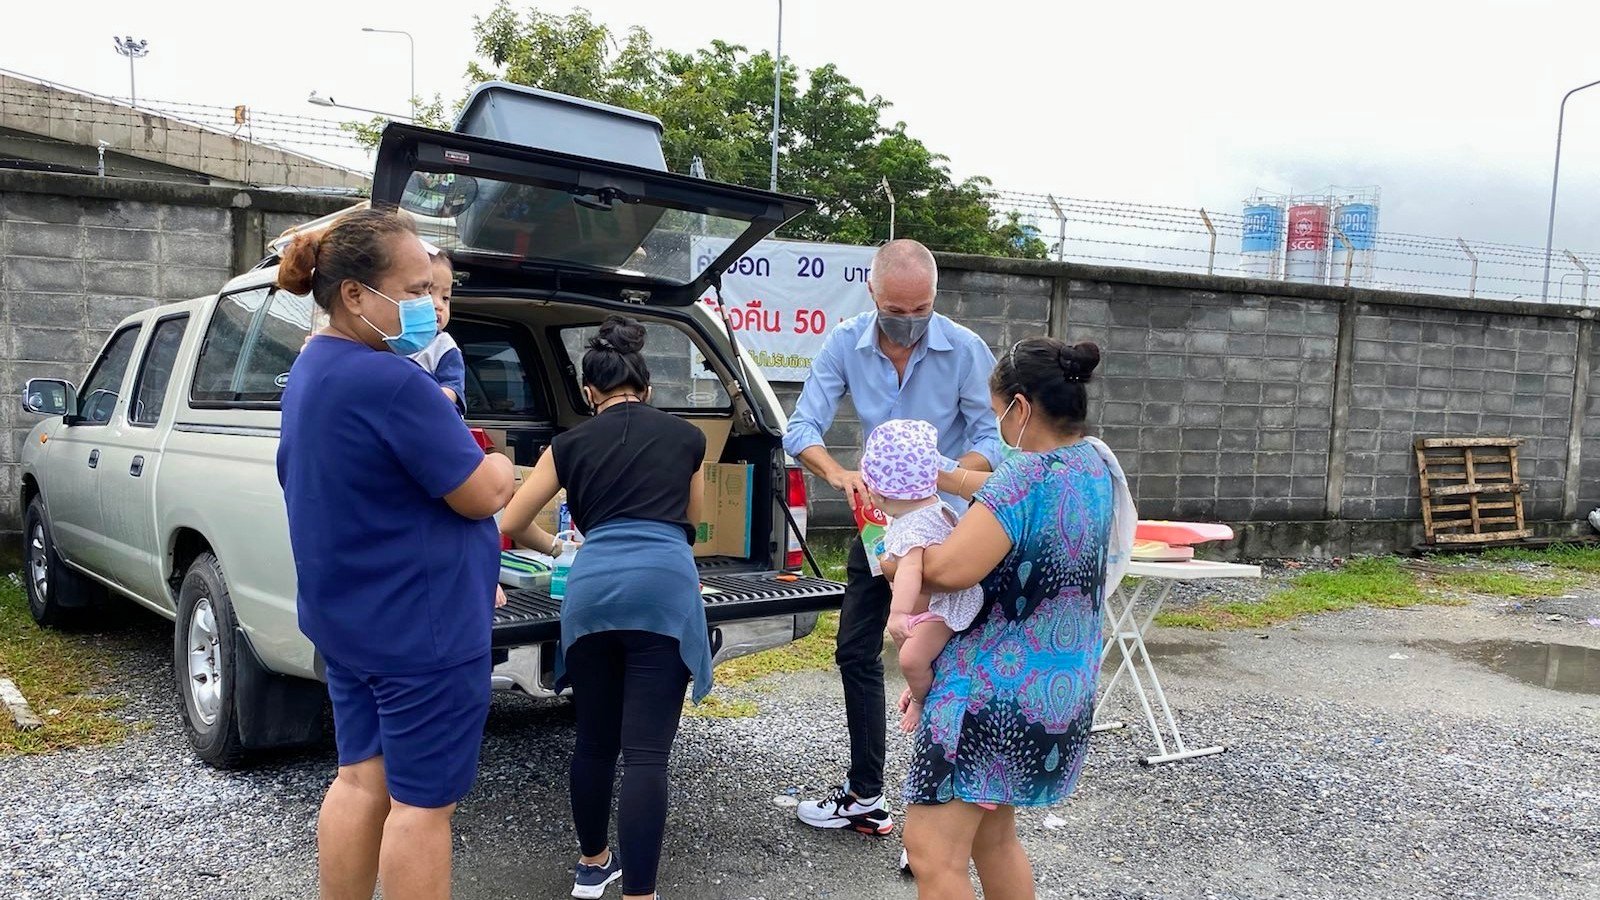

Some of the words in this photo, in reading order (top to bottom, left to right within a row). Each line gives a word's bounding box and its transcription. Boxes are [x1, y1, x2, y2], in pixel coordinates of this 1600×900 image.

[1339, 213, 1367, 231] CPAC
[1291, 240, 1315, 251] SCG
[697, 248, 770, 277] ค่อด
[797, 256, 825, 278] 20
[793, 309, 827, 334] 50
